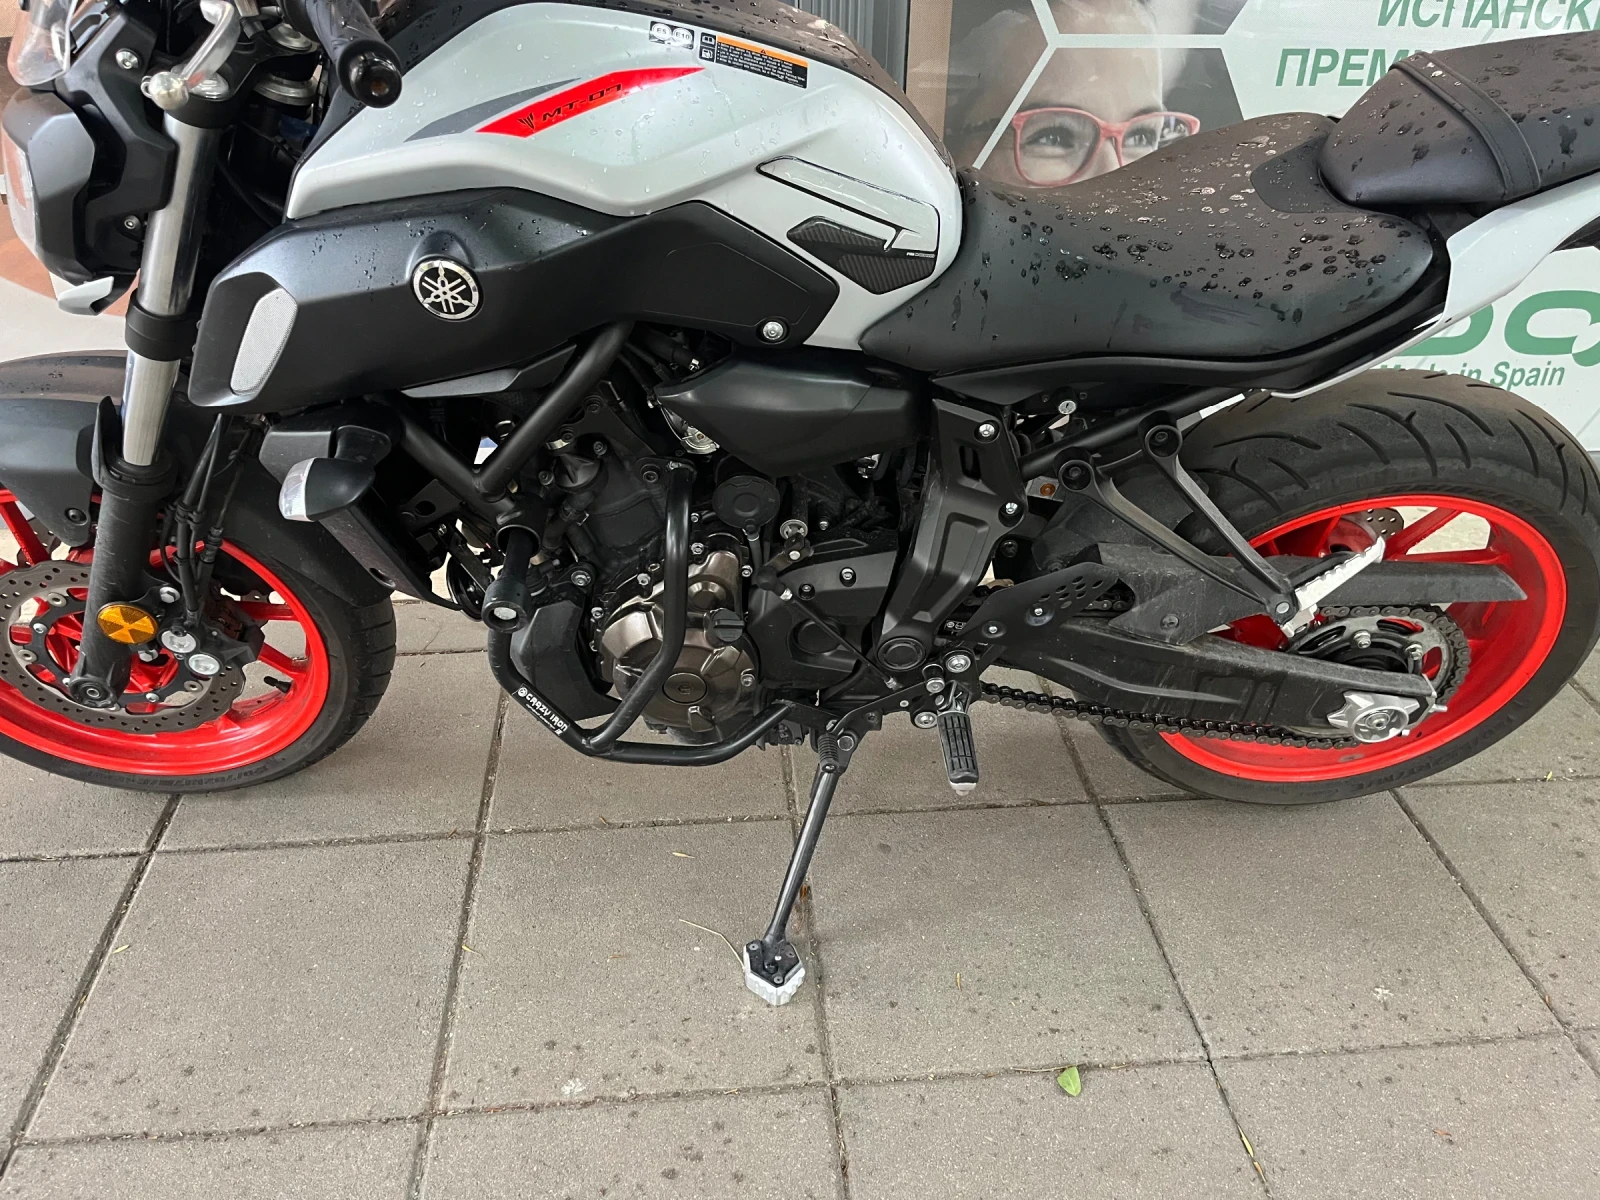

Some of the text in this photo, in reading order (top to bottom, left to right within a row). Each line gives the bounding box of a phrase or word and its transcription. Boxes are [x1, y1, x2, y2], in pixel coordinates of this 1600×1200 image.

[1377, 0, 1600, 31] ИСПАНСК
[542, 83, 622, 122] MT-07
[1489, 360, 1566, 391] Spain
